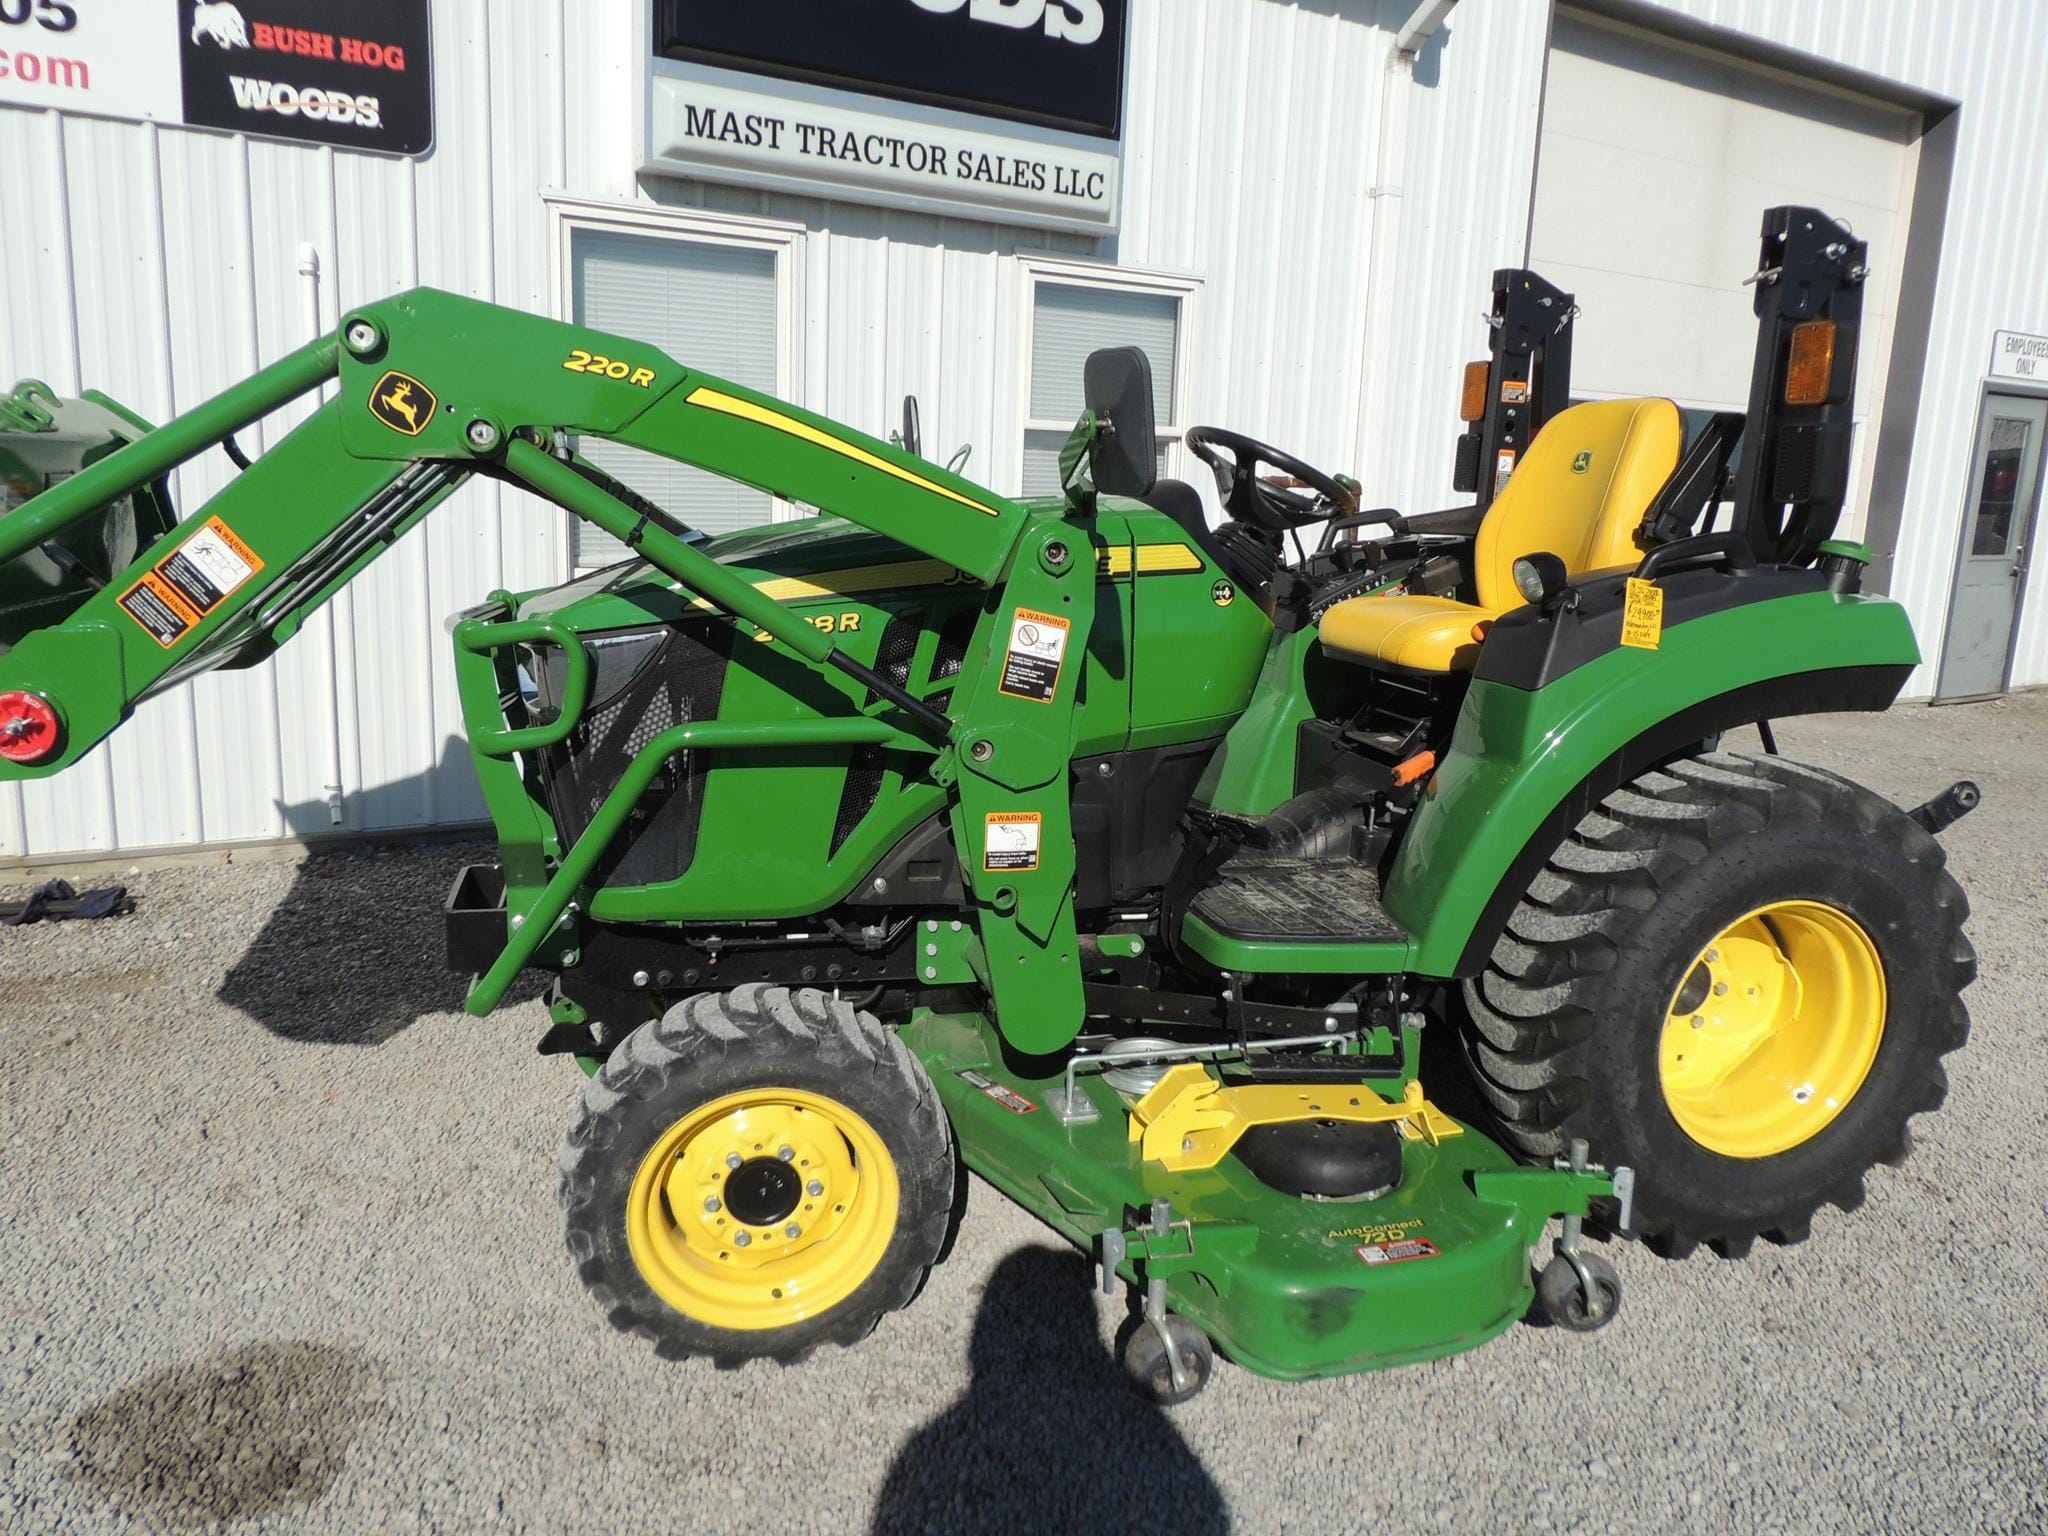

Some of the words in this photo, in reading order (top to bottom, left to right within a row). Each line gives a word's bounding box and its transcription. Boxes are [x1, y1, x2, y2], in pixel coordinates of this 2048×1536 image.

[253, 22, 335, 61] BUSH
[340, 37, 405, 71] HOG
[229, 75, 381, 129] WOODS
[684, 104, 784, 150] MAST
[796, 123, 947, 176] TRACTOR
[957, 150, 1046, 191] SALES
[1053, 166, 1104, 200] LLC
[2016, 358, 2037, 375] ONLY
[222, 531, 256, 565] WARNING
[158, 588, 192, 621] WARNING
[1026, 611, 1067, 628] WARNING
[997, 814, 1038, 822] WARNING
[1328, 1219, 1425, 1239] AutoConnect
[1359, 1229, 1405, 1244] 72D
